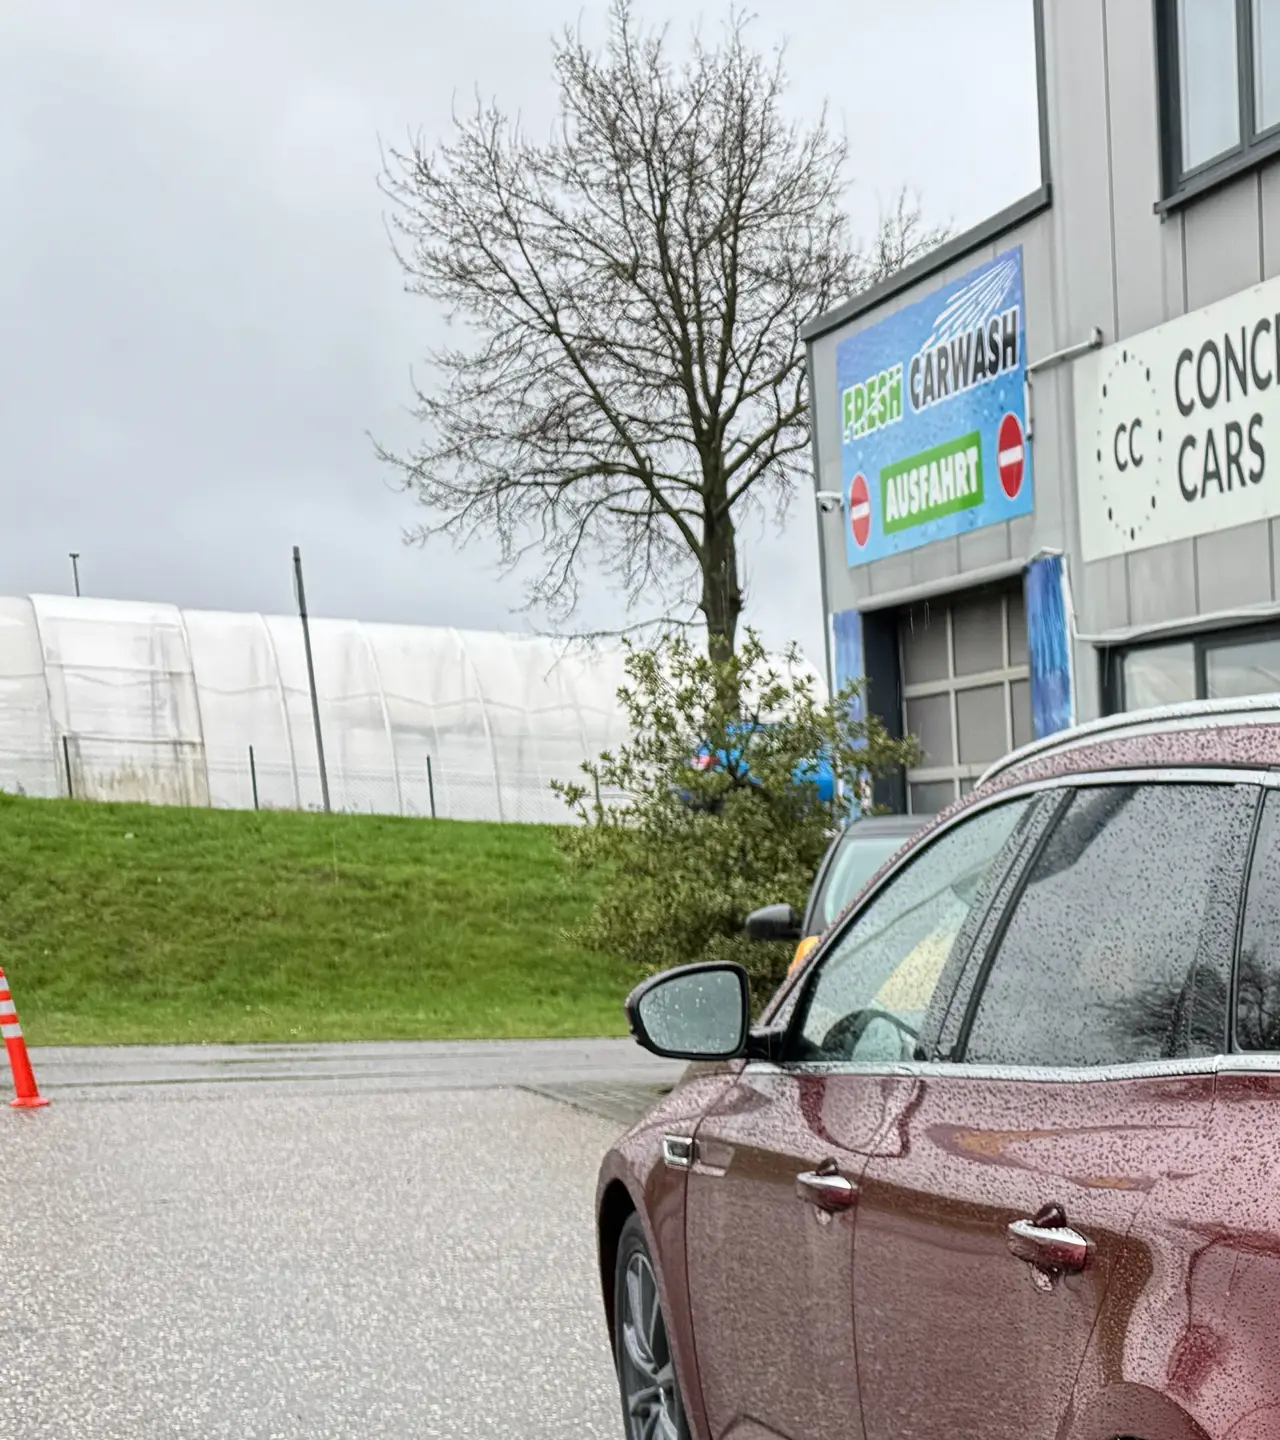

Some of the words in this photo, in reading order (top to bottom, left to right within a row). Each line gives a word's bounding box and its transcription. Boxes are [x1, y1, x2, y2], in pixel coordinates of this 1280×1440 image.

[843, 364, 903, 444] FRESH
[909, 305, 1019, 414] CARWASH
[886, 446, 979, 523] AUSFAHRT
[1114, 418, 1143, 472] CC
[1178, 412, 1265, 502] CARS
